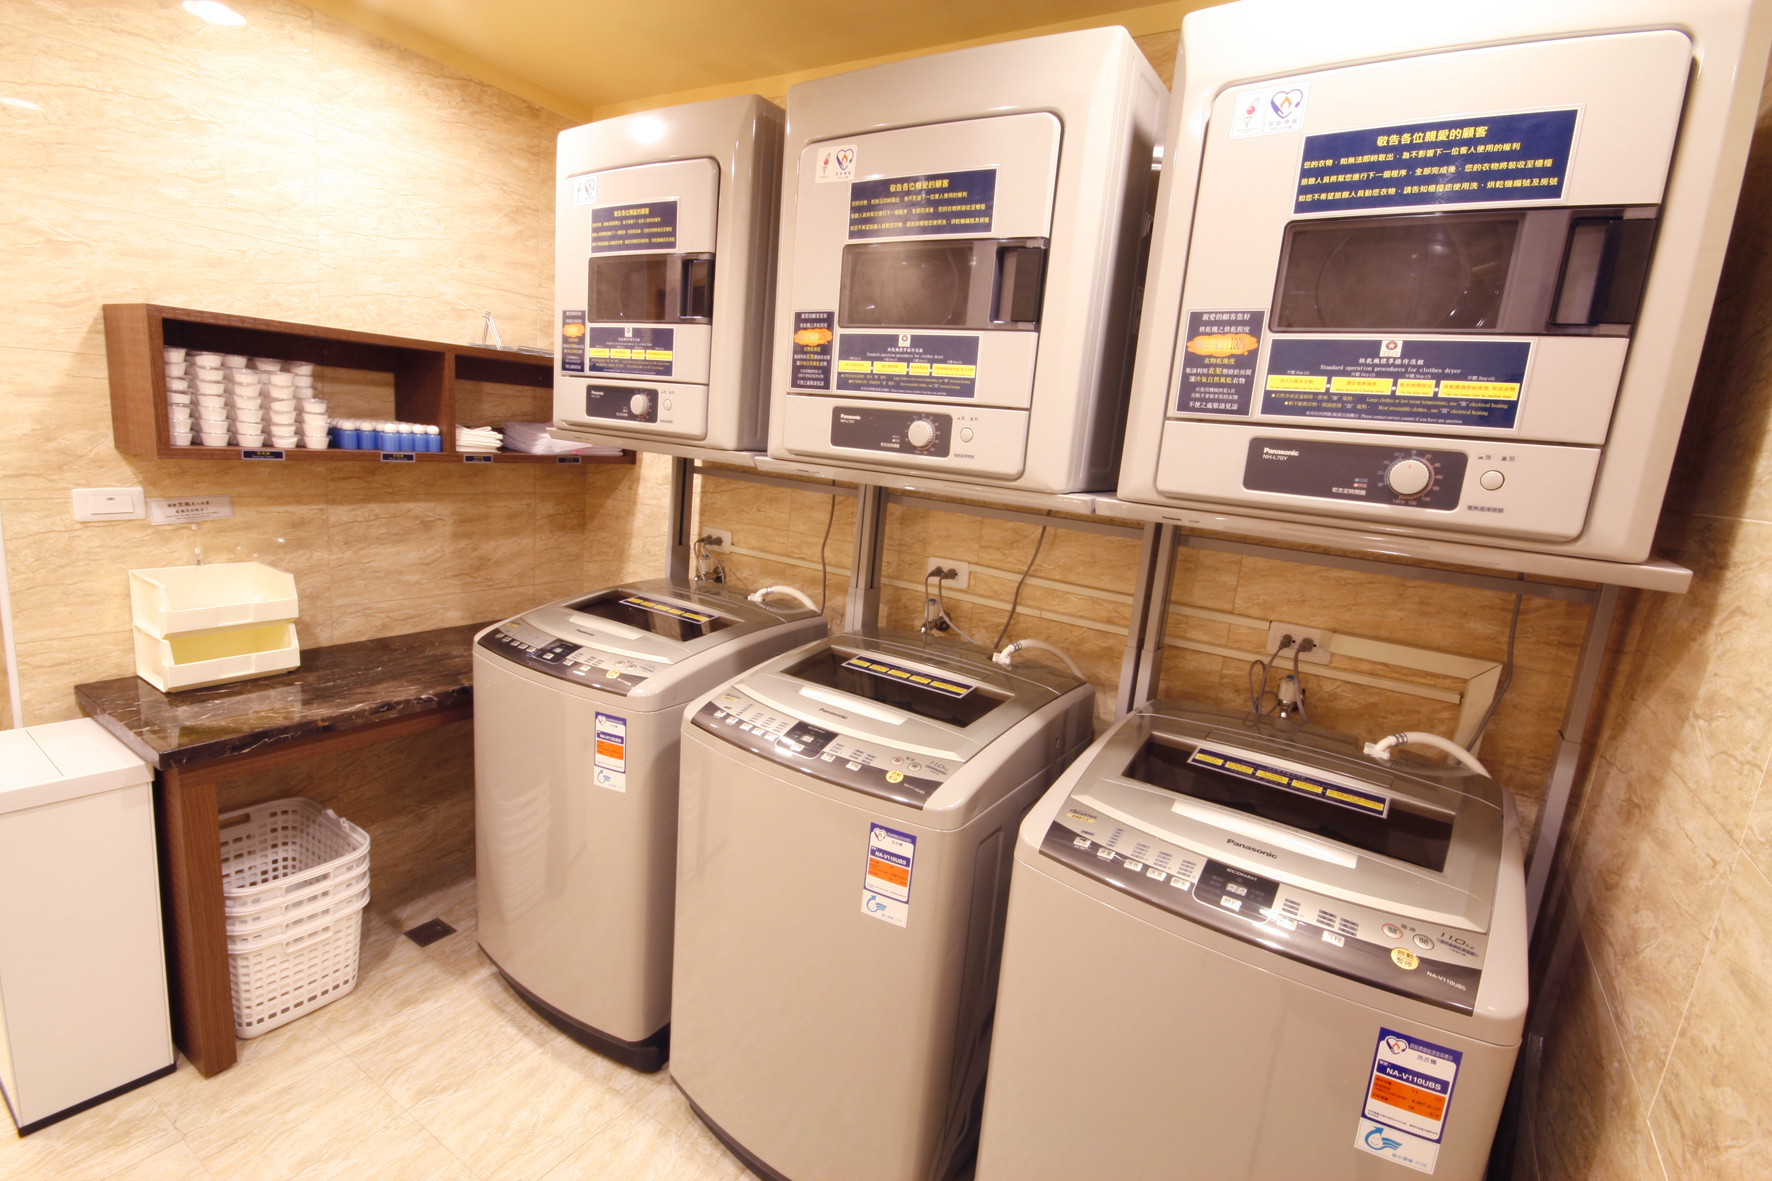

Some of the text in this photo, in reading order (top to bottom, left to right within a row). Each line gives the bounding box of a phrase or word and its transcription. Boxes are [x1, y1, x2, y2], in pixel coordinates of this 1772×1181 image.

[1376, 126, 1488, 148] 敬告各位親愛的顧客
[1202, 313, 1251, 321] 親愛的顧客您好
[1320, 364, 1343, 372] Standard
[1345, 365, 1373, 374] operation
[1374, 366, 1405, 374] procedures
[1444, 368, 1462, 376] dryer
[1189, 401, 1239, 410] 不便之處敬請見諒
[840, 413, 861, 421] Panasonic
[1263, 447, 1300, 457] Panasonic
[575, 628, 596, 637] Panasonic
[818, 707, 849, 720] Panasonic
[1226, 838, 1278, 859] Panasonic
[875, 850, 907, 866] NA-V110UBS
[1226, 868, 1258, 882] ECONAVI
[1440, 932, 1466, 946] 11.0
[1426, 970, 1466, 991] NA-V110UBS
[1416, 1054, 1437, 1066] 洗衣機
[1386, 1067, 1442, 1091] NA-V110UBS
